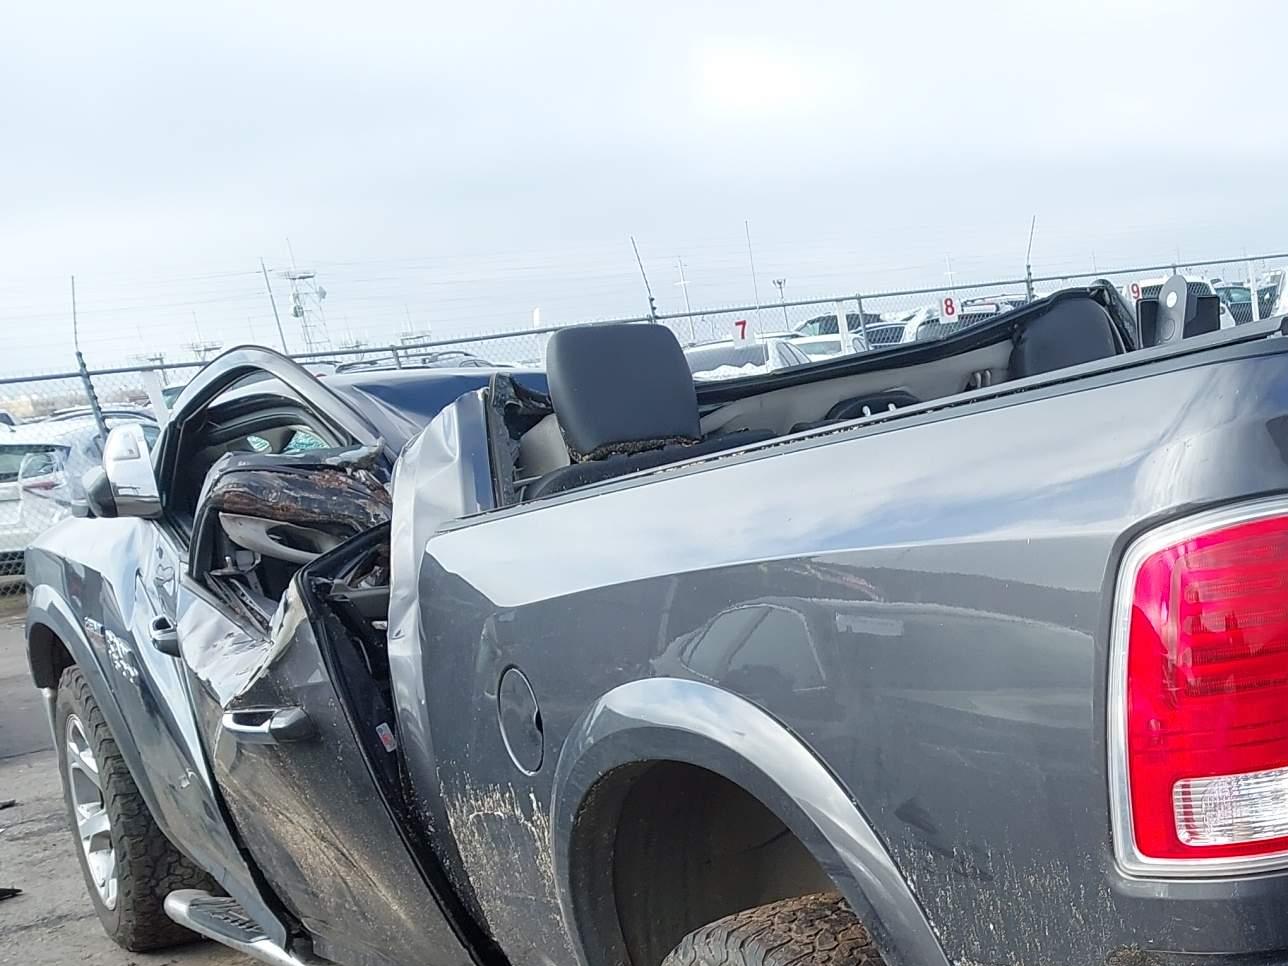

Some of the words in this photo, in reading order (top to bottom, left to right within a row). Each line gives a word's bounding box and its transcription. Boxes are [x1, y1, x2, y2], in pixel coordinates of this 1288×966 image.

[1131, 283, 1140, 299] 9
[944, 298, 955, 316] 8
[735, 320, 747, 340] 7
